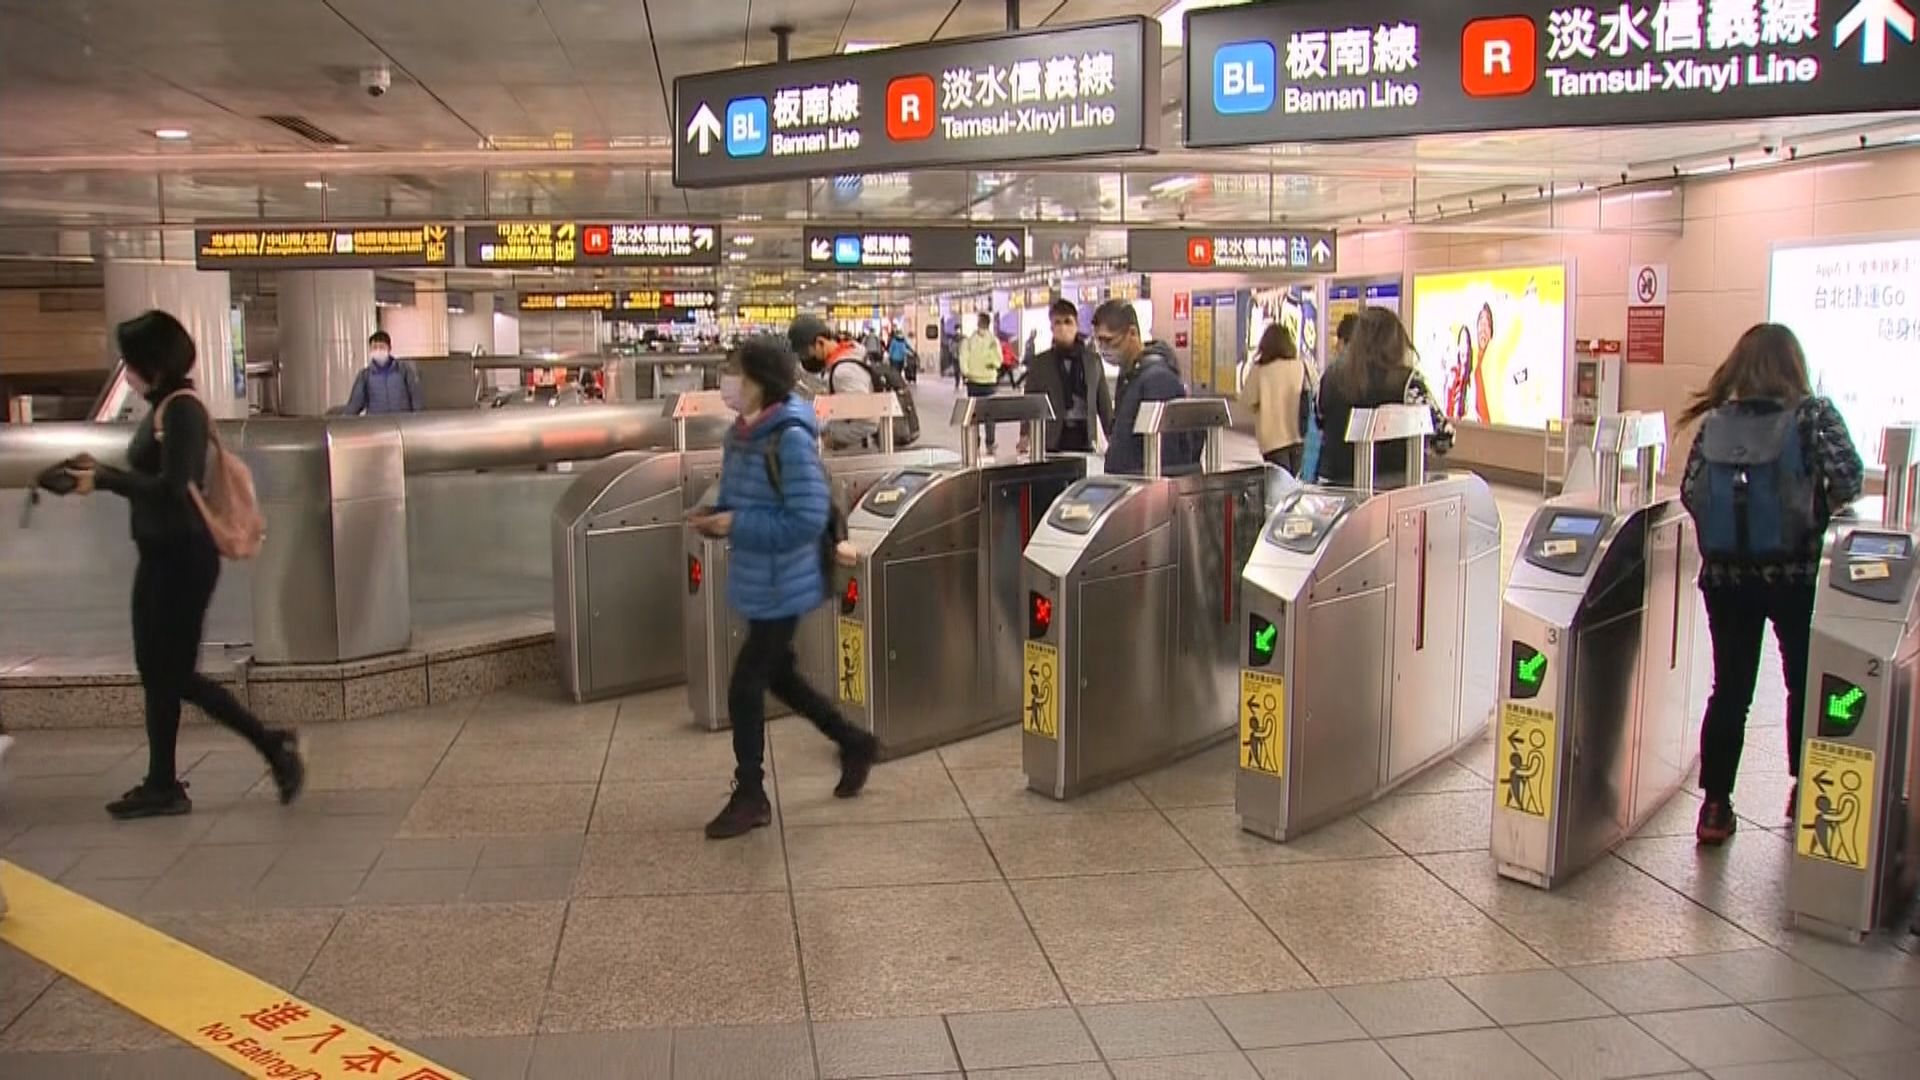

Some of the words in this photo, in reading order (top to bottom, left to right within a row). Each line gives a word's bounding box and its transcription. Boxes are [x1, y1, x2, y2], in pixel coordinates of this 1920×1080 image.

[1546, 0, 1819, 60] 淡水信義線
[1285, 22, 1419, 80] 板南線
[1482, 40, 1512, 75] R
[942, 52, 1115, 110] 淡水信義線
[1222, 60, 1265, 96] BL
[1545, 58, 1739, 97] Tamsui-Xinyi
[1748, 54, 1818, 85] Line
[773, 81, 860, 129] 板南線
[901, 94, 921, 123] R
[1284, 87, 1366, 114] Bannan
[1371, 80, 1419, 108] Line
[732, 113, 761, 142] BL
[941, 105, 1066, 139] Tamsui-Xinyi
[1070, 102, 1115, 129] Line
[772, 132, 826, 156] Bannan
[828, 127, 860, 150] Line
[1548, 628, 1557, 645] 3
[1867, 659, 1880, 677] 2
[198, 1022, 234, 1041] No
